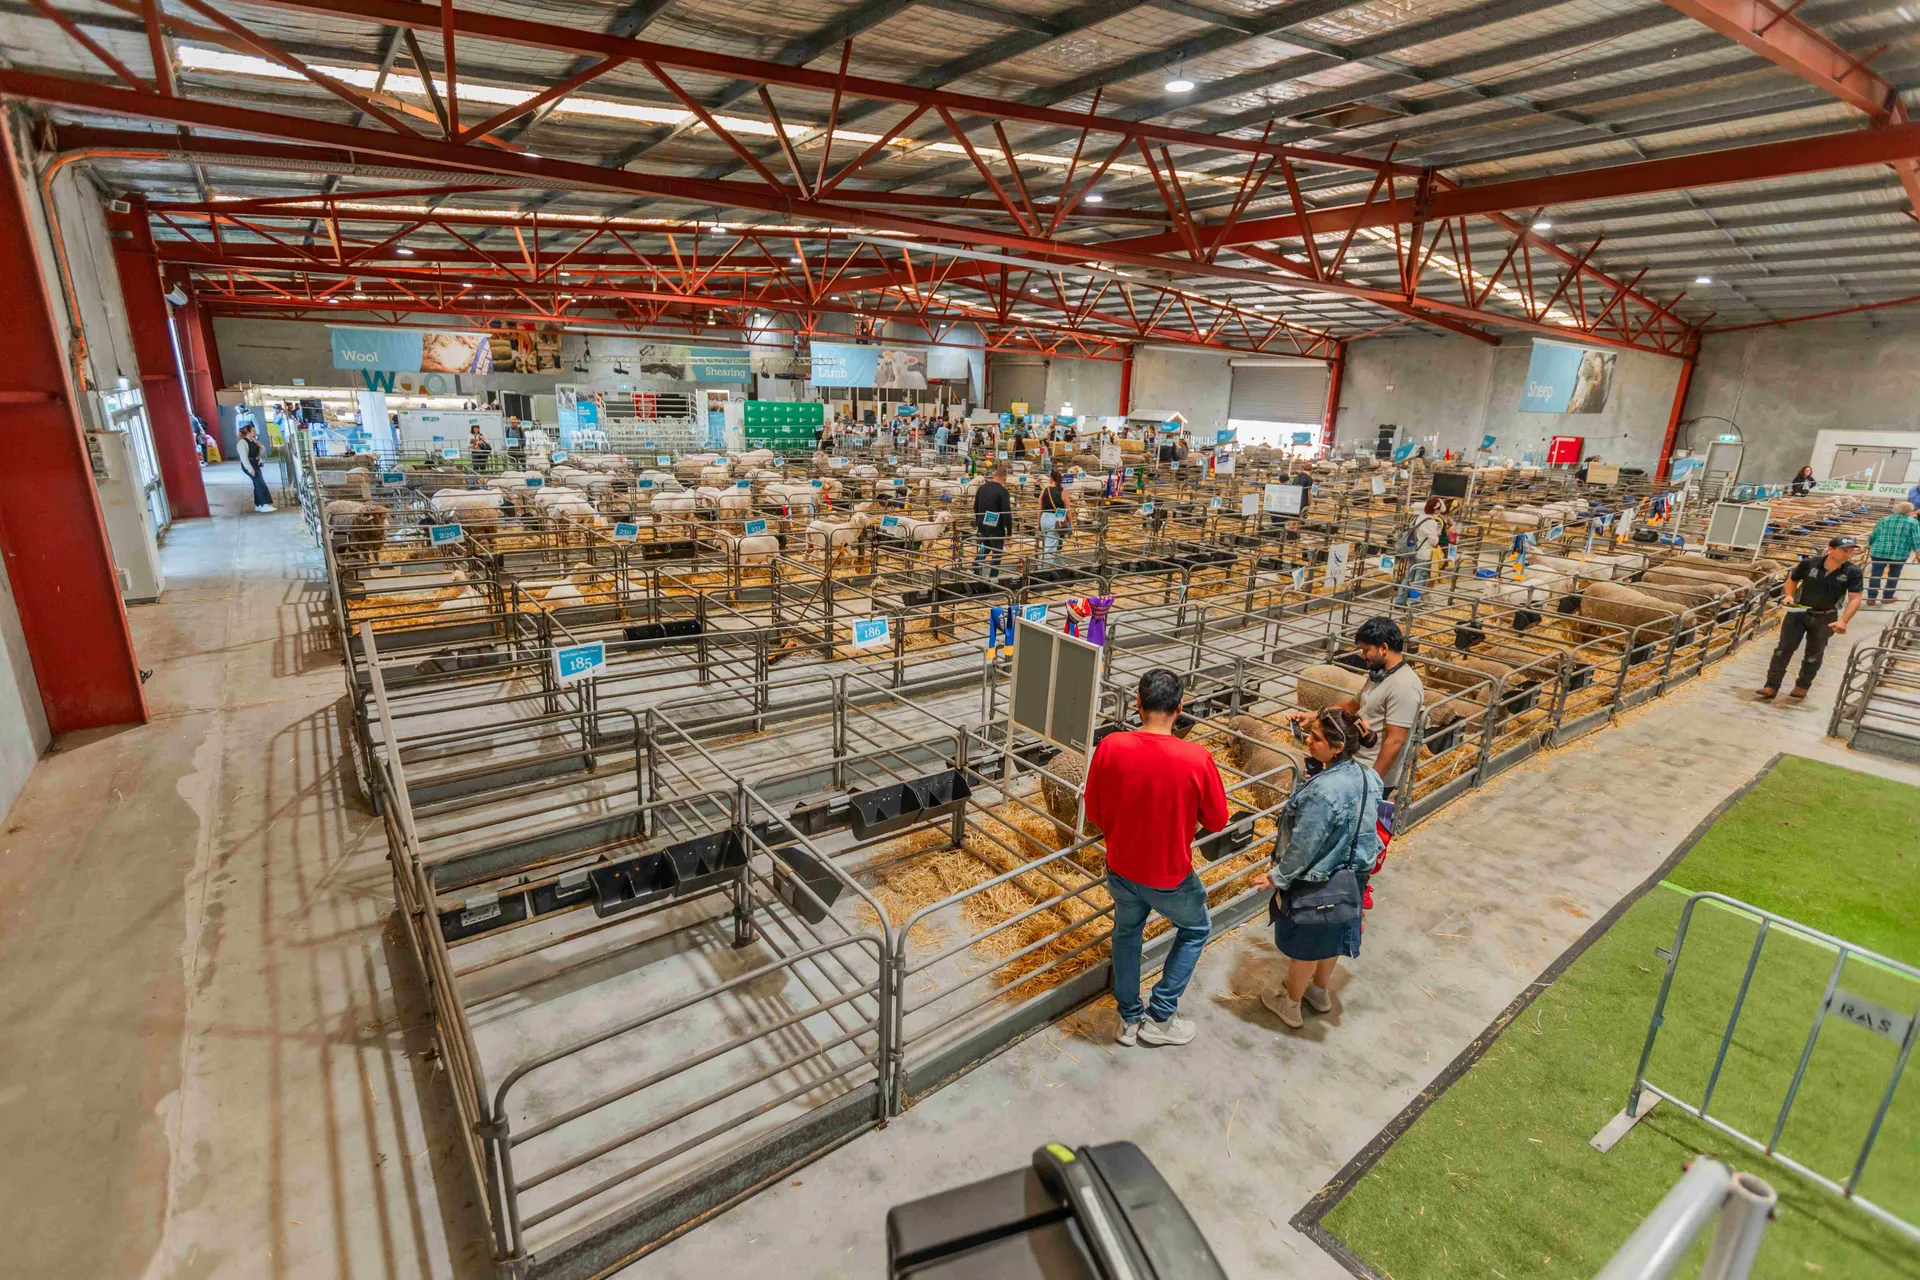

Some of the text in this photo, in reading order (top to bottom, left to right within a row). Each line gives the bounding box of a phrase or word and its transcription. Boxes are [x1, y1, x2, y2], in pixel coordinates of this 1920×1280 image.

[341, 349, 379, 363] Wool
[839, 357, 846, 367] a
[705, 366, 746, 379] Shearing
[818, 367, 848, 379] Lamb
[1527, 380, 1554, 402] Sheep
[1878, 486, 1907, 494] OFFICE
[438, 531, 456, 539] 229
[1029, 611, 1042, 622] 187
[864, 625, 881, 638] 186
[569, 656, 593, 671] 185
[1840, 1002, 1892, 1034] RAS
